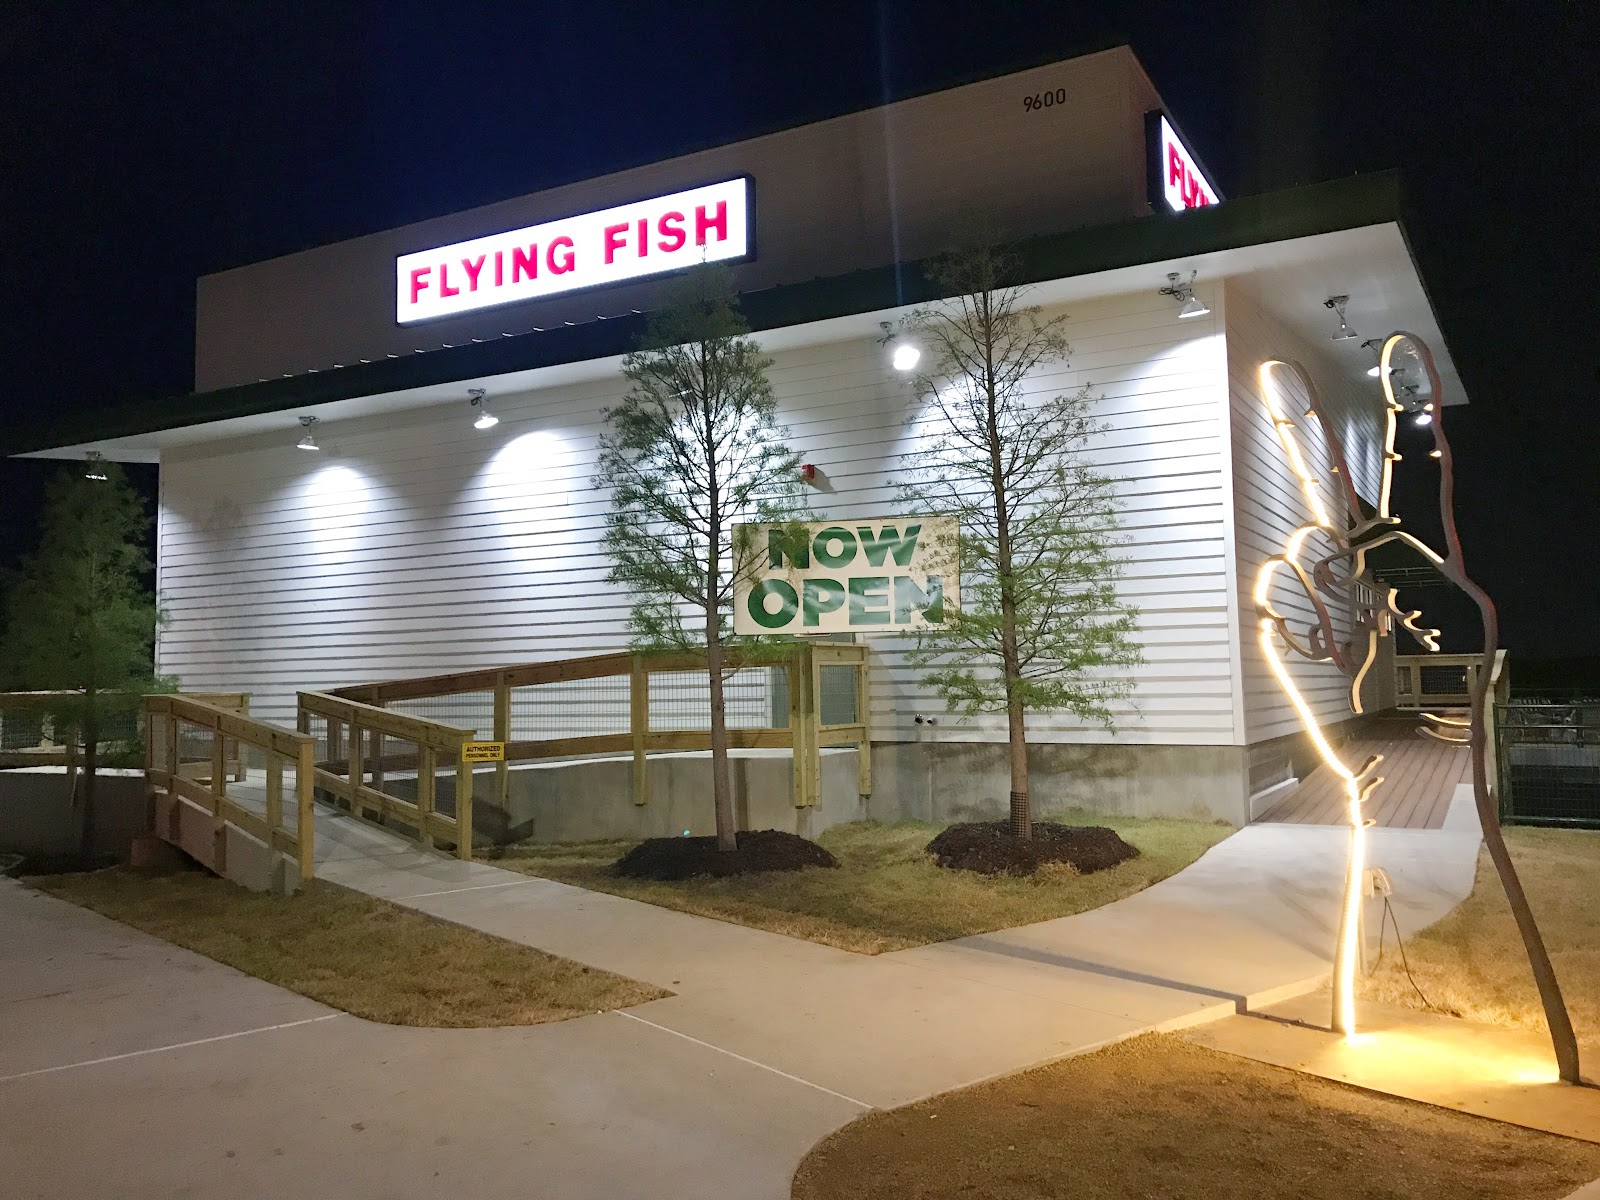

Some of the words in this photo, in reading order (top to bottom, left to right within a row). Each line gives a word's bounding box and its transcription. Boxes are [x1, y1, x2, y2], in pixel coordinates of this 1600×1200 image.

[1023, 88, 1066, 112] 9600
[410, 235, 575, 304] FLYING
[603, 200, 728, 265] FISH
[768, 524, 922, 570] NOW
[747, 575, 944, 629] OPEN
